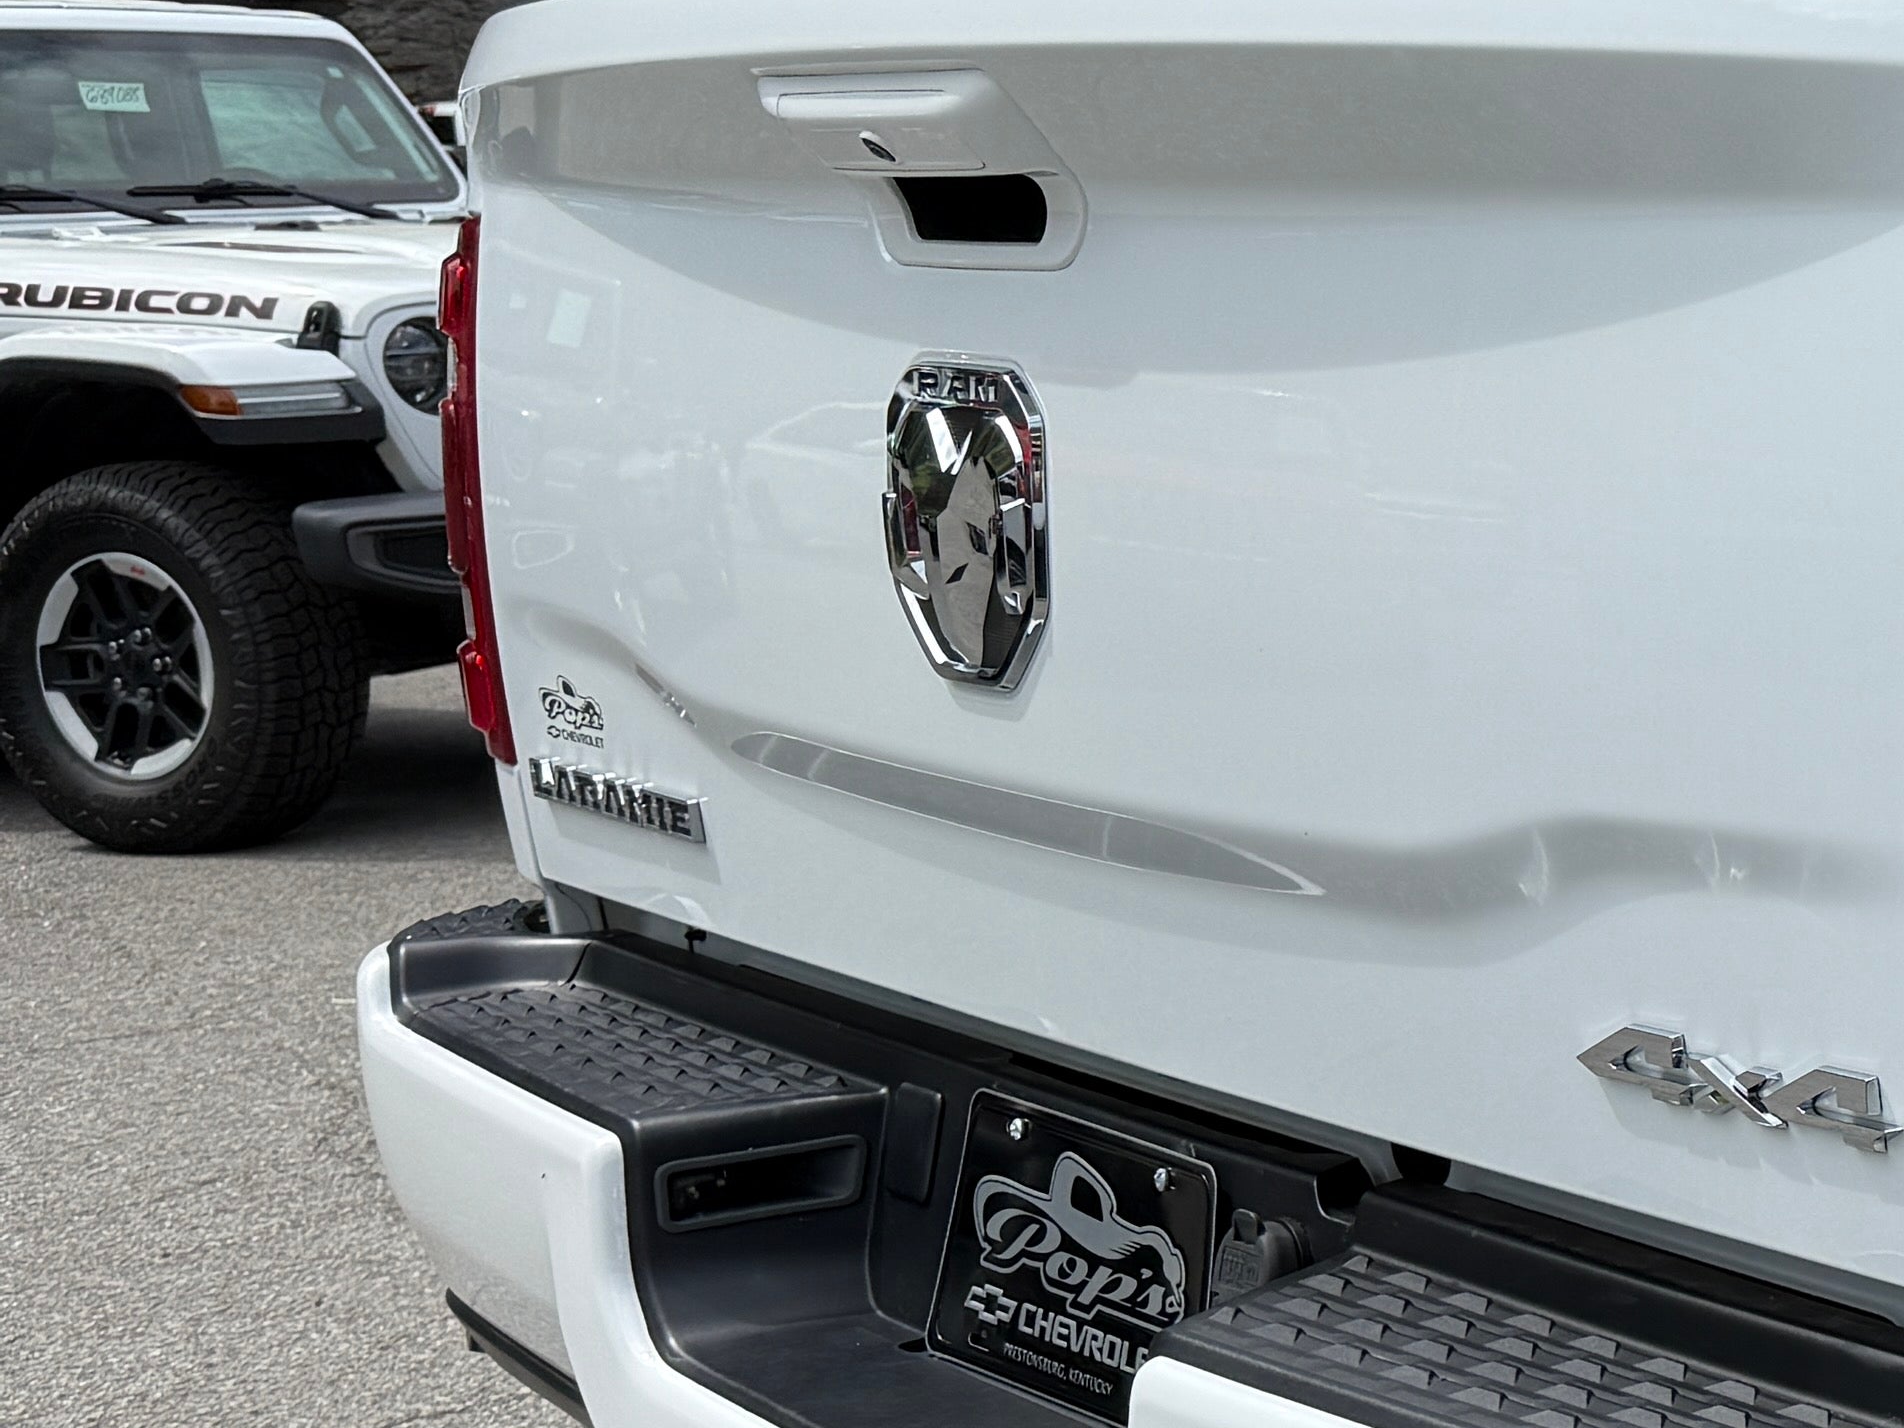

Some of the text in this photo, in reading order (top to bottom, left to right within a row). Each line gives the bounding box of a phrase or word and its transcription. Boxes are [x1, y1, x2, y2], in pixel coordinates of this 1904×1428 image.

[0, 282, 279, 320] RUBICON
[912, 370, 999, 403] RAM
[529, 755, 707, 844] LARAMIE
[985, 1207, 1183, 1322] Pop's
[1018, 1302, 1149, 1376] CHEVROLE
[1069, 1367, 1114, 1396] KENTUCKY
